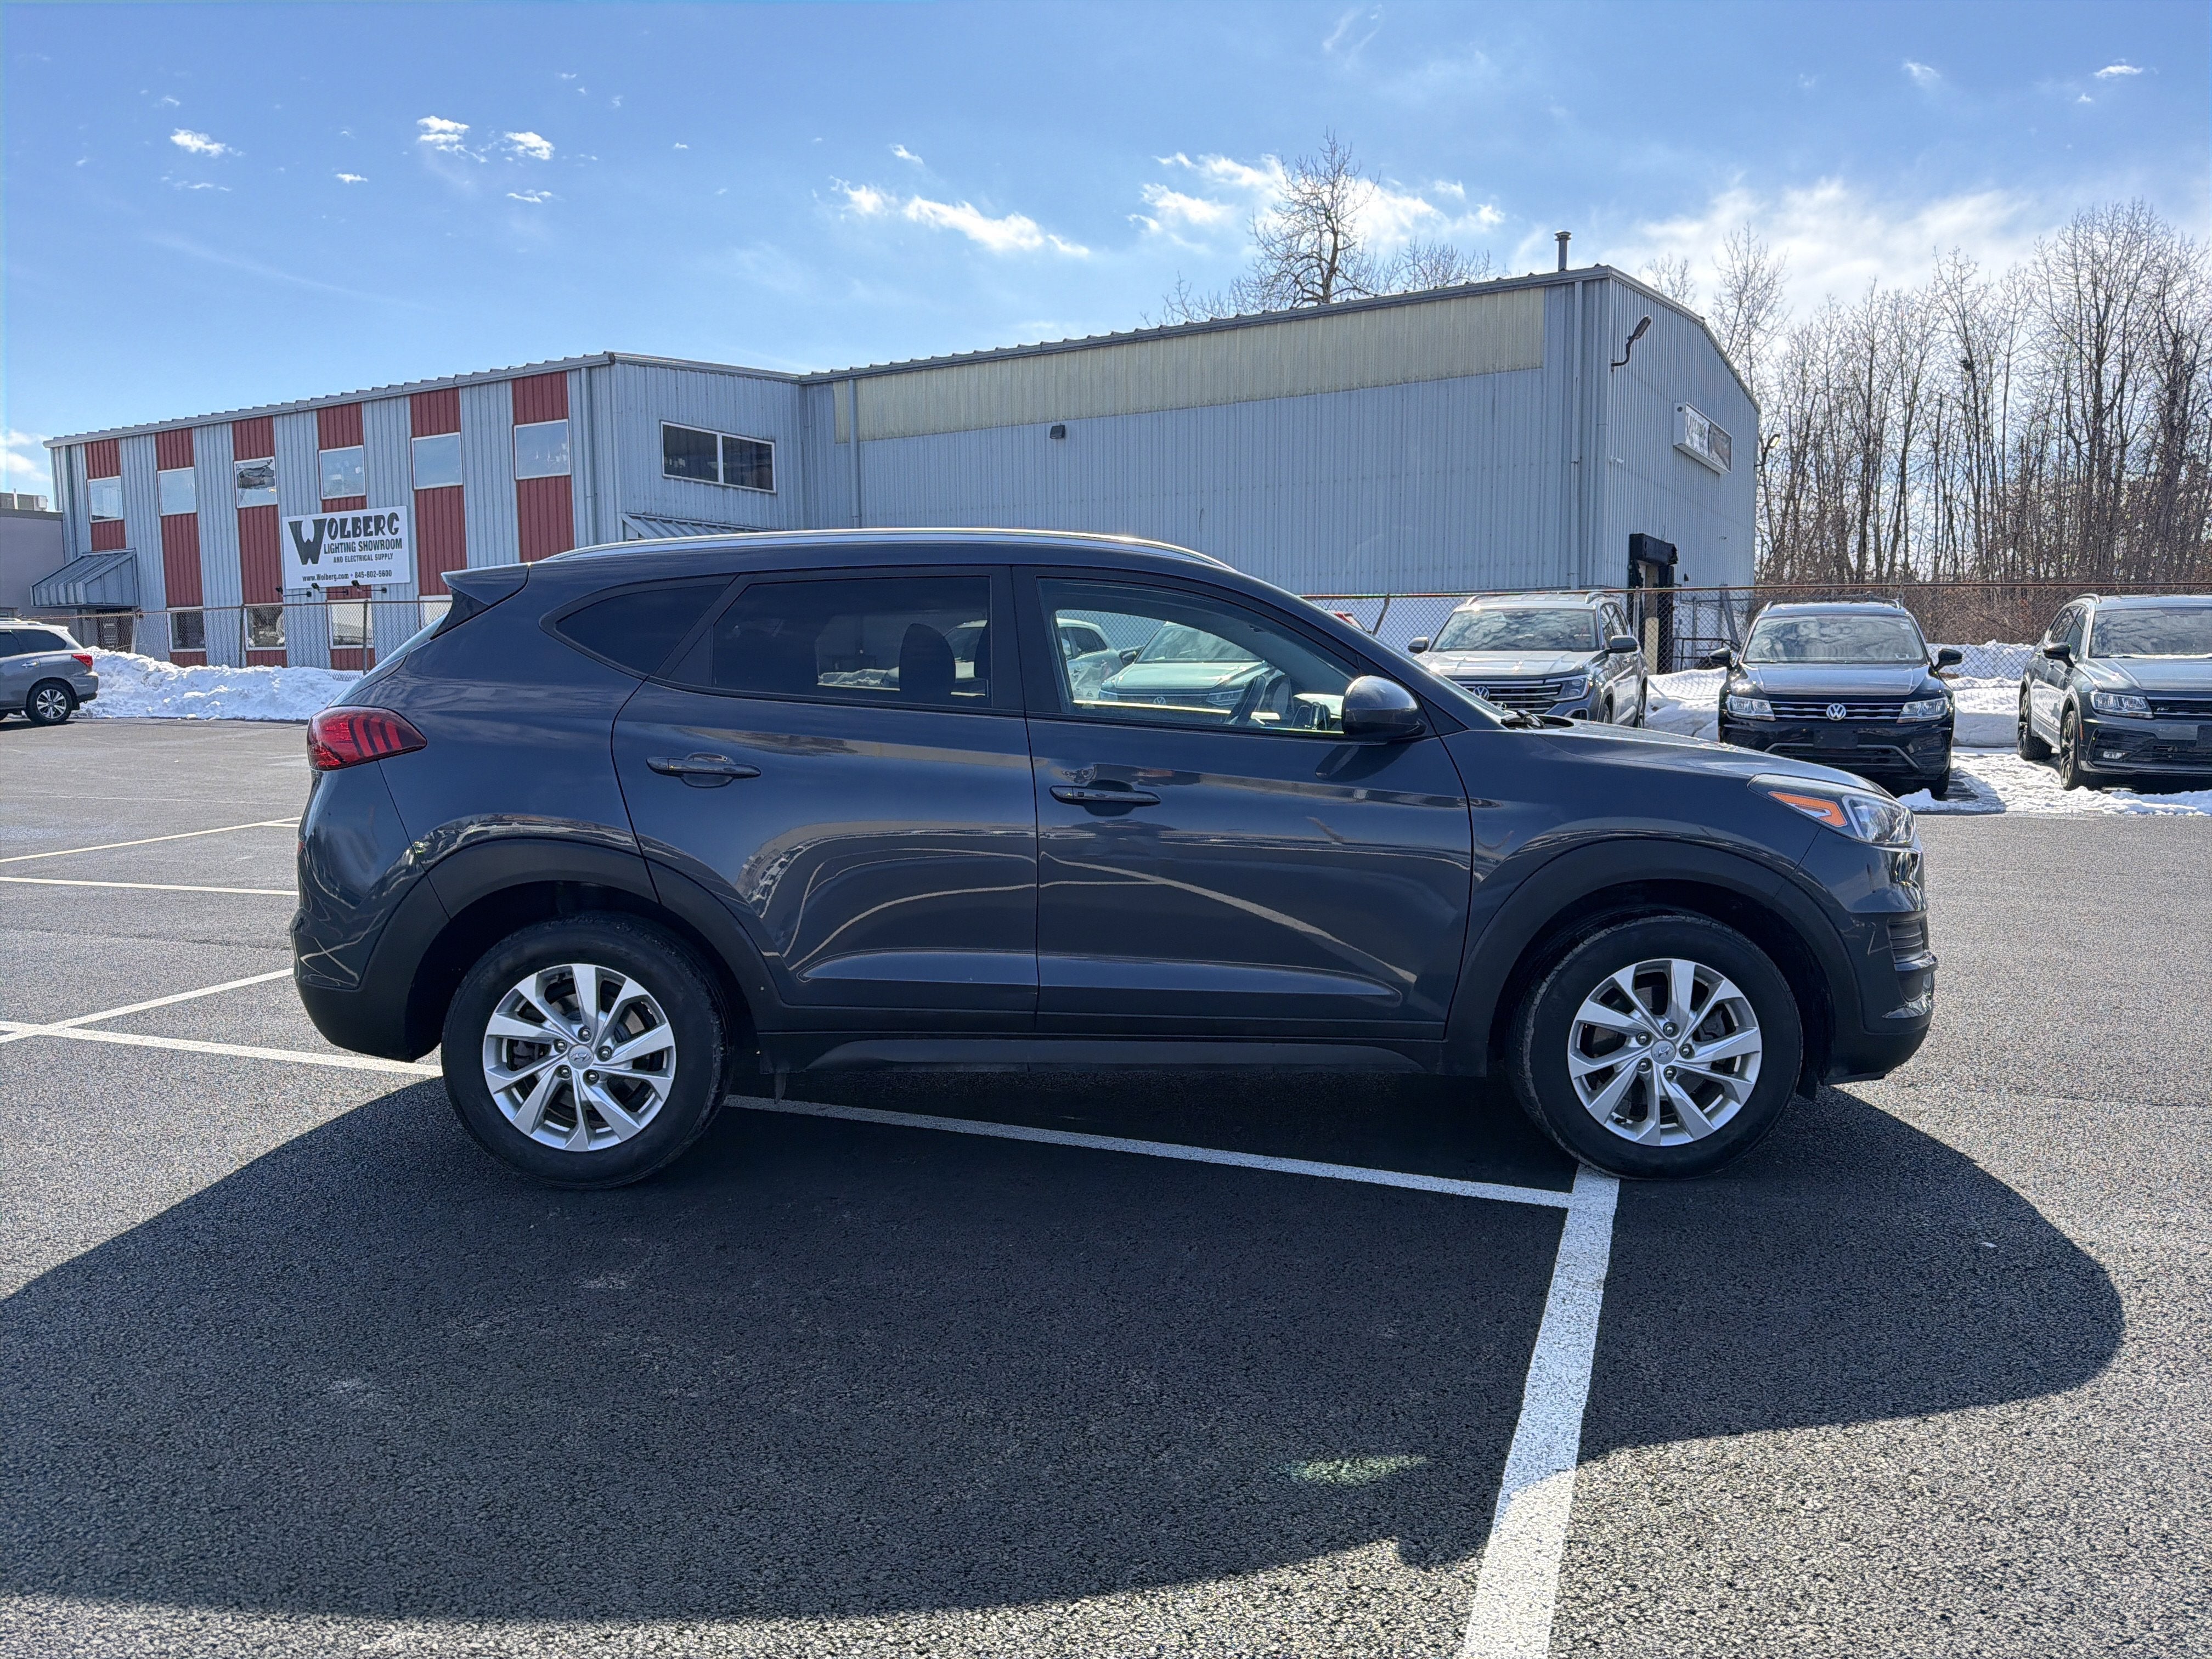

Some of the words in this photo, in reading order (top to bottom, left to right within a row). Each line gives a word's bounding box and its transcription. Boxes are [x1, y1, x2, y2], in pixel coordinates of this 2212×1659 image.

[288, 512, 400, 565] WOLBERG
[324, 541, 356, 554] LIGHTING
[358, 538, 402, 552] SHOWROOM
[345, 554, 374, 563] ELECTRICAL
[375, 552, 393, 561] SUPPLY
[302, 573, 349, 582] www.Wolberg.com
[354, 569, 392, 579] 845-802-5600
